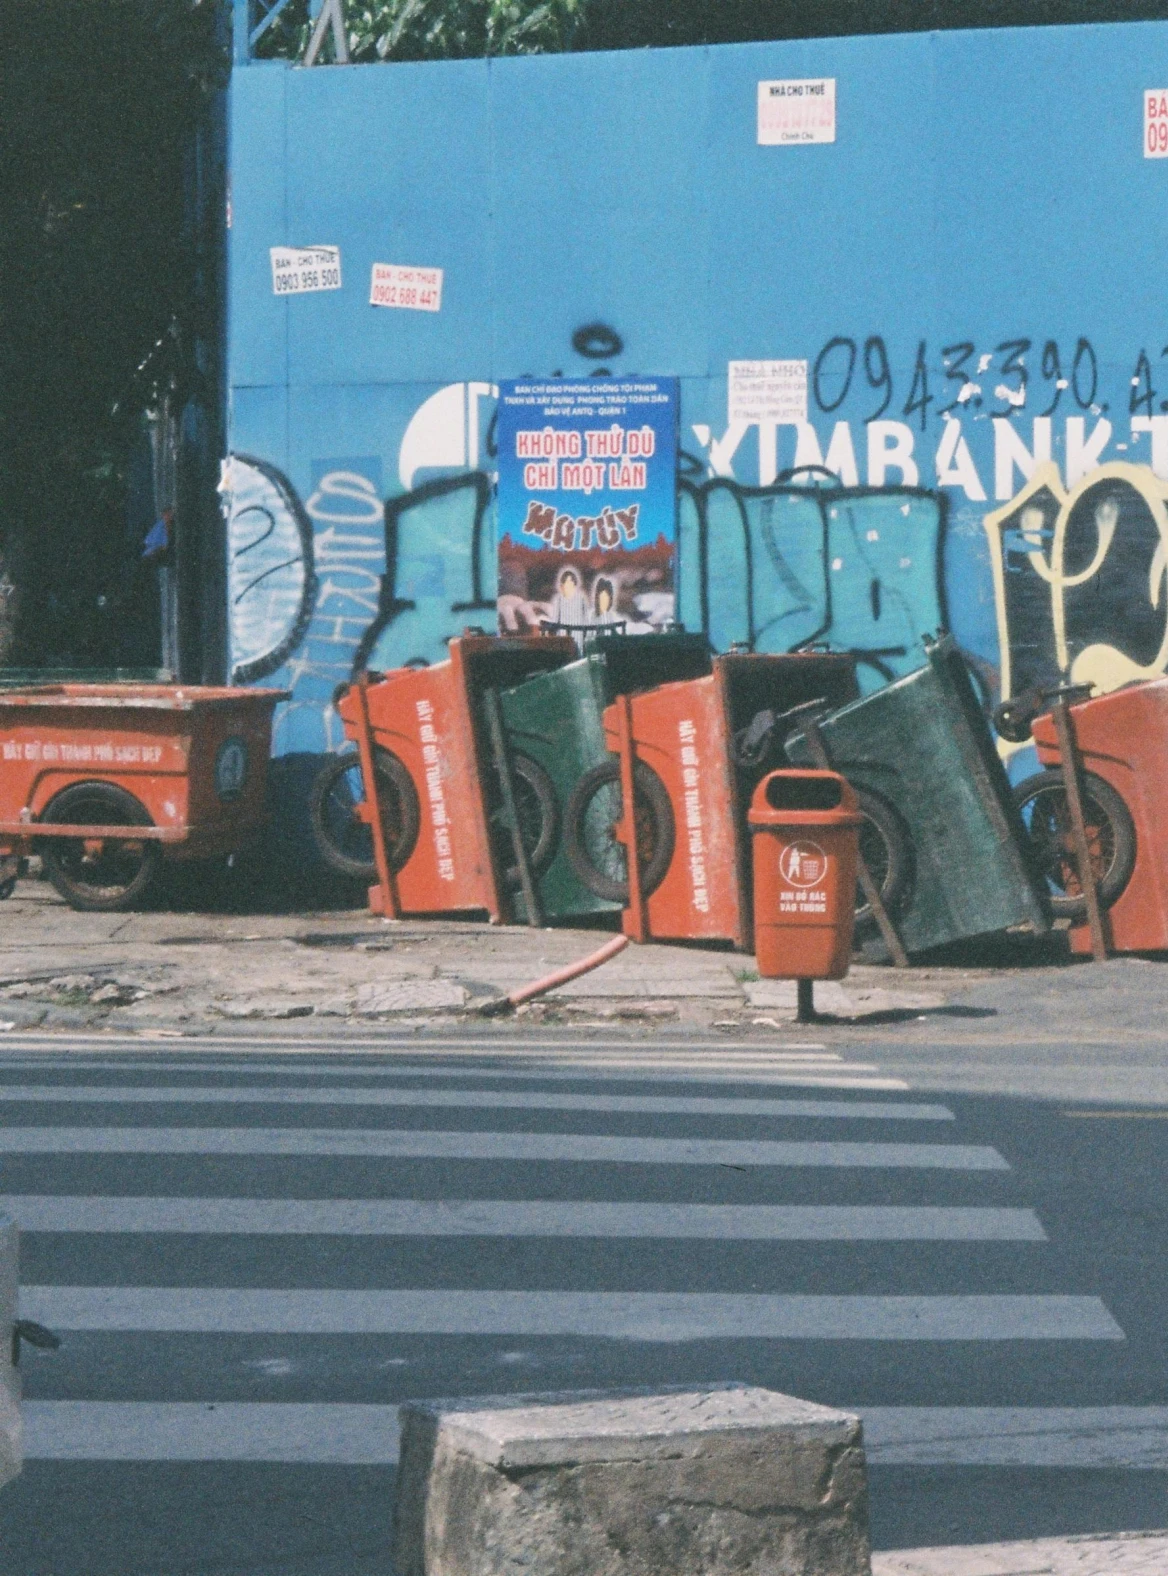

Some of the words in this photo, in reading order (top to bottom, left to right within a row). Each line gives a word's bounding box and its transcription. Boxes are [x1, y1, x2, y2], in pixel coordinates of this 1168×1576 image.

[786, 85, 803, 96] CHO
[298, 256, 313, 266] CHO
[275, 273, 299, 291] 0903
[302, 271, 318, 288] 956
[321, 269, 339, 286] 500
[398, 271, 414, 282] CHO
[372, 285, 396, 303] 0902
[419, 290, 437, 305] 447
[517, 427, 580, 458] KHÔNG
[586, 424, 624, 458] THỬ
[628, 426, 654, 458] DÙ
[525, 457, 557, 489] CHỈ
[562, 458, 605, 494] MỘT
[609, 455, 646, 489] LẦN
